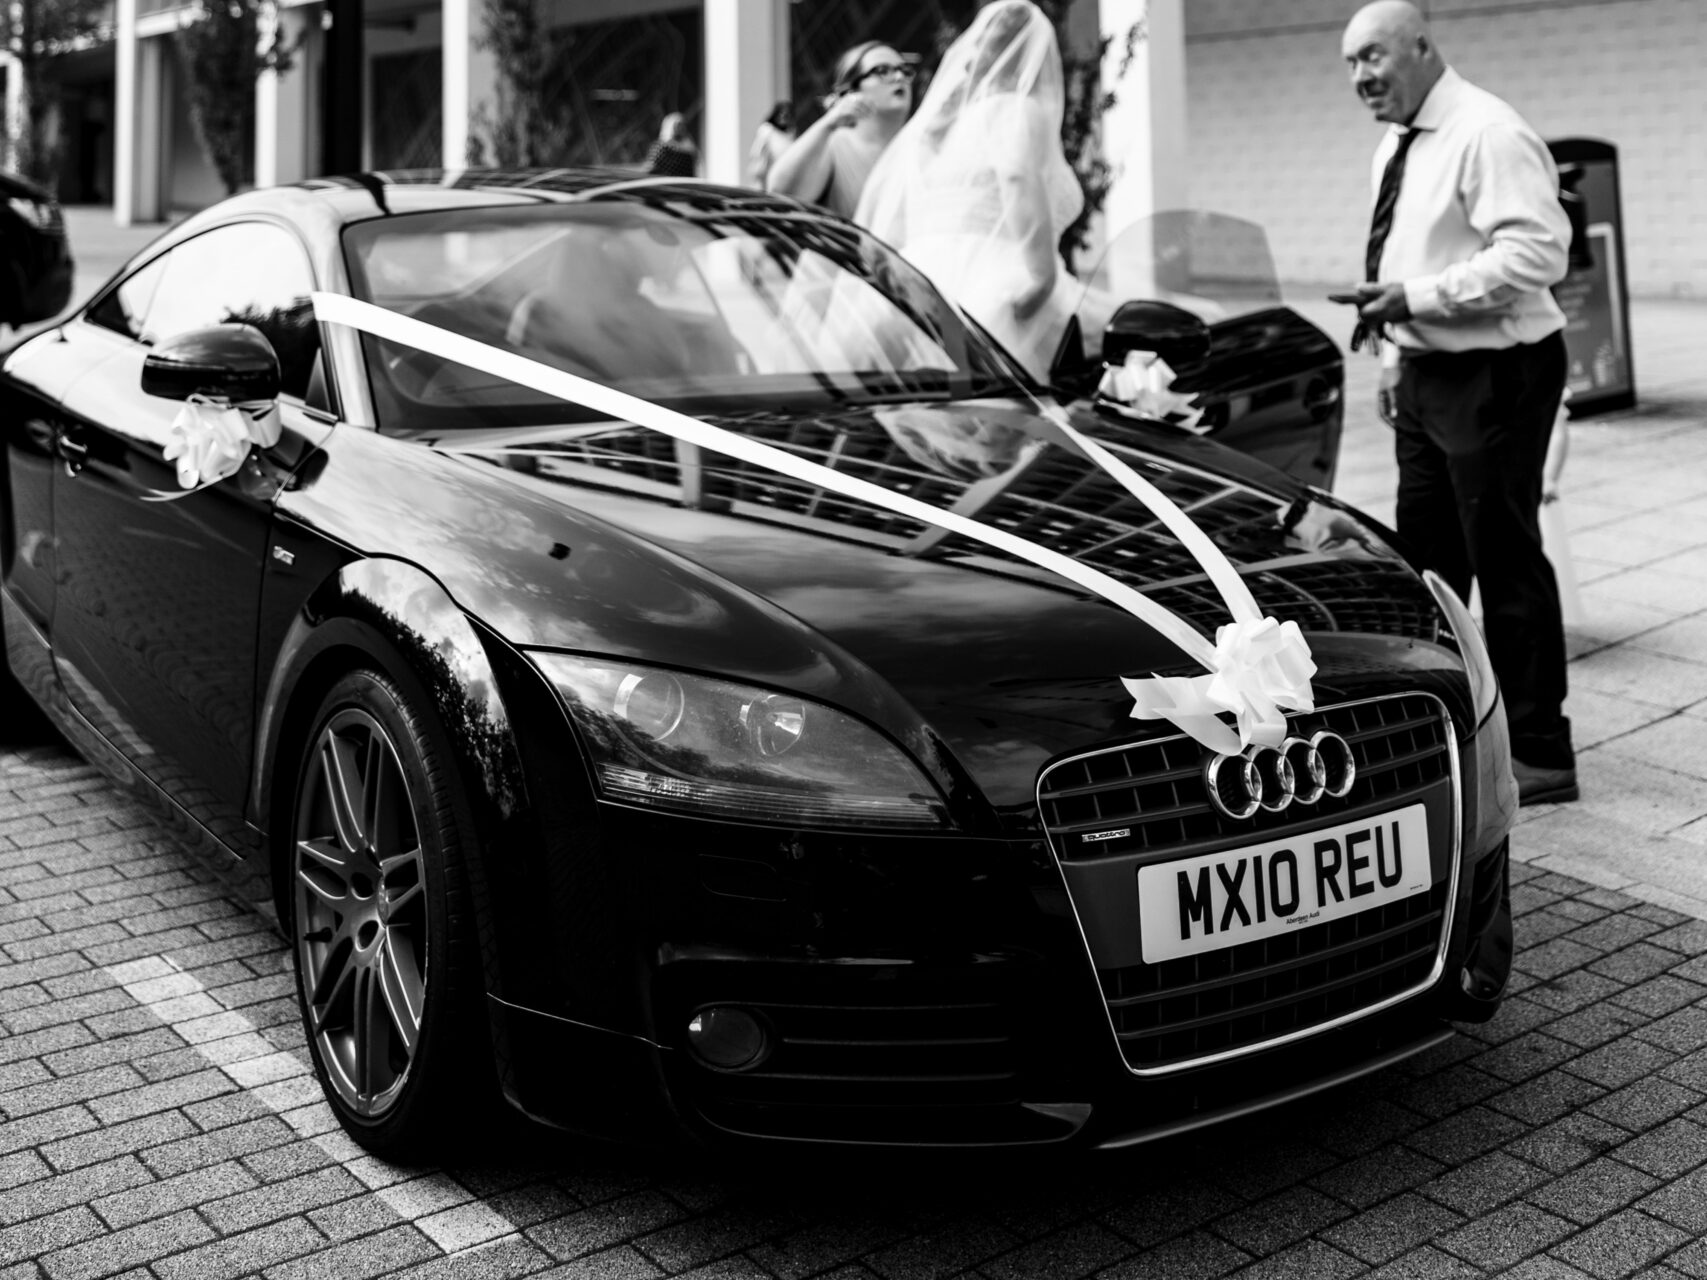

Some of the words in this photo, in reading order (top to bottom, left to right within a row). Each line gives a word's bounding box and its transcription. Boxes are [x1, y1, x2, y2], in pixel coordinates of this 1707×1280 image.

[1085, 829, 1127, 841] quattro
[1177, 849, 1300, 940] MX10
[1313, 821, 1403, 908] REU
